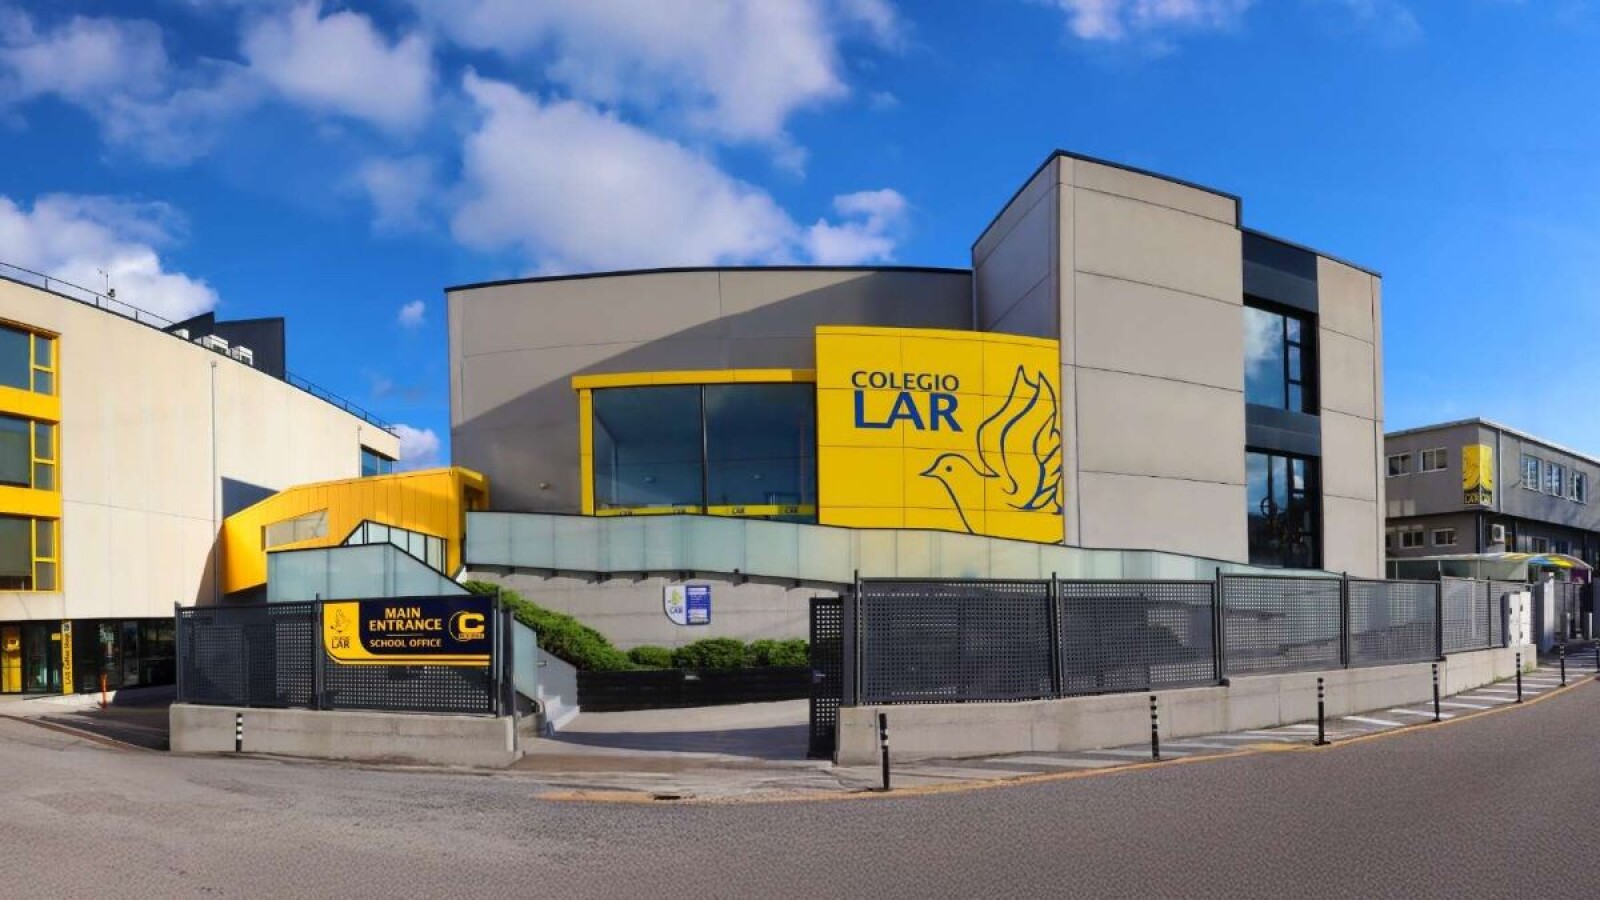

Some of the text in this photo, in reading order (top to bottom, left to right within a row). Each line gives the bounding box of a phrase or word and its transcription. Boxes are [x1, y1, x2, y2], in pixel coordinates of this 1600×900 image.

[851, 371, 960, 392] COLEGIO
[854, 390, 963, 432] LAR
[384, 607, 421, 620] MAIN
[369, 618, 442, 632] ENTRANCE
[331, 639, 350, 648] LAR
[369, 638, 442, 648] SCHOOL OFFICE
